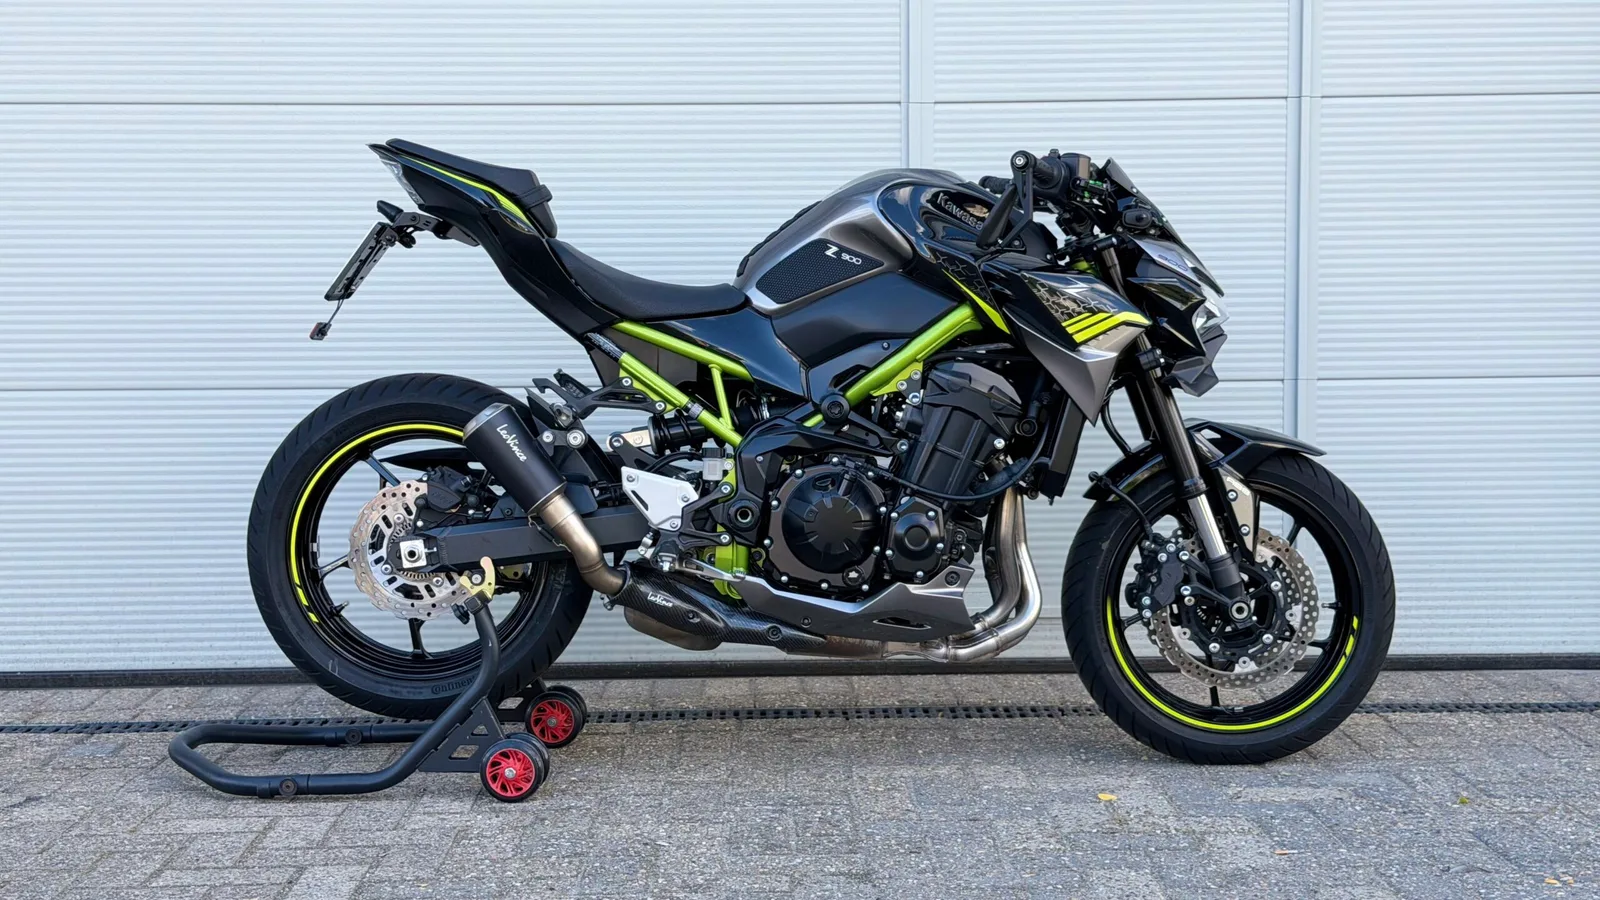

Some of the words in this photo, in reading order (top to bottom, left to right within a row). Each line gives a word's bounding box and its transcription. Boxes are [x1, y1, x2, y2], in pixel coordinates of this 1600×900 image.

[936, 192, 984, 231] Kawasa
[824, 243, 840, 259] Z
[841, 252, 862, 265] 900
[496, 423, 527, 462] LeoVince
[431, 675, 475, 695] Continen
